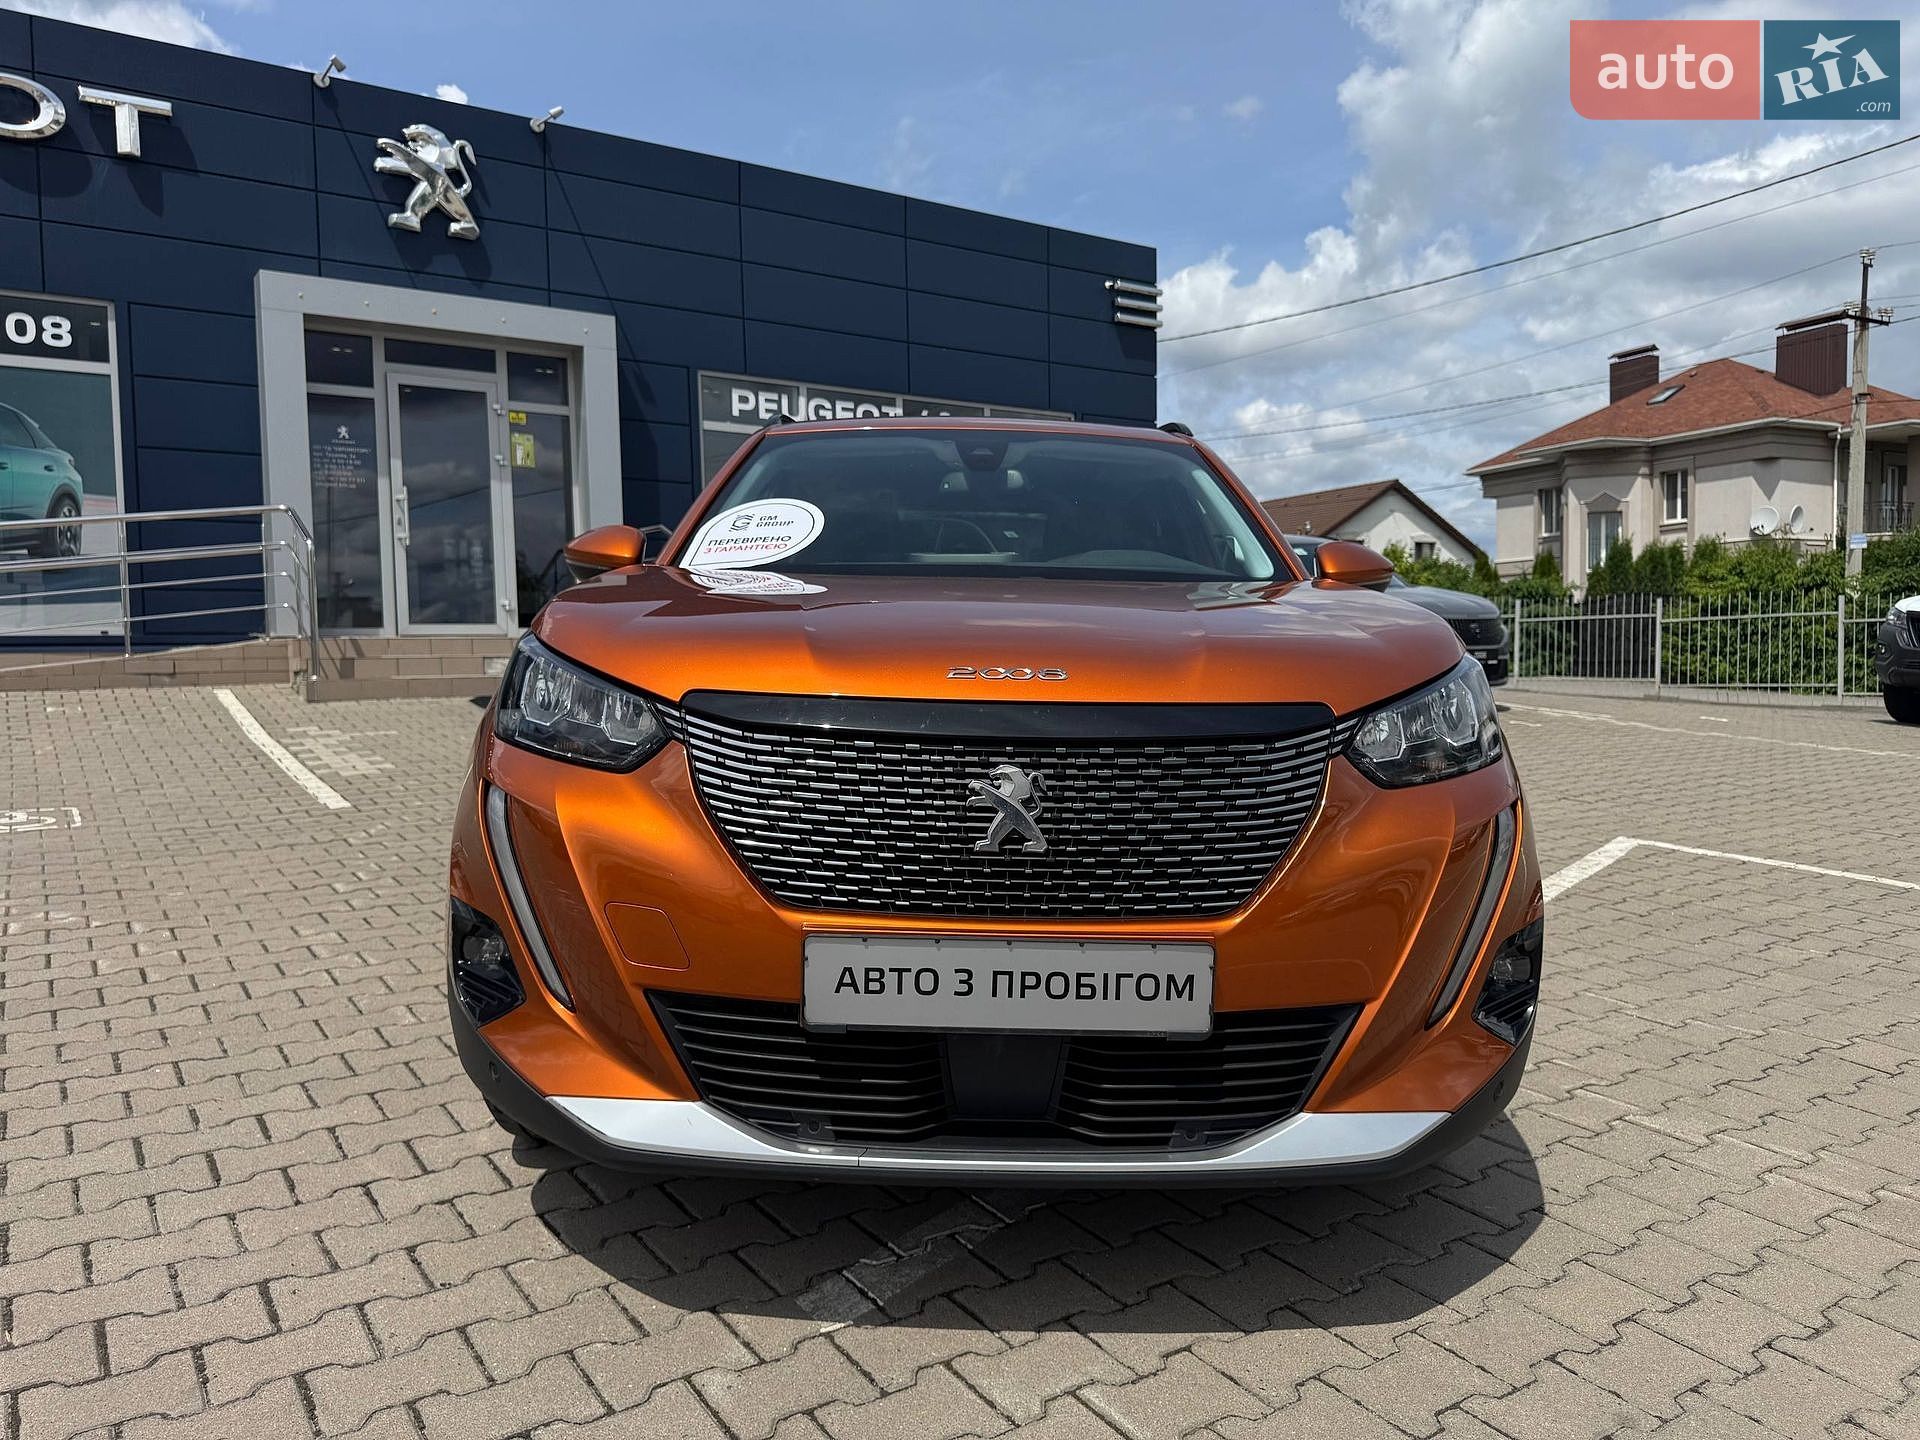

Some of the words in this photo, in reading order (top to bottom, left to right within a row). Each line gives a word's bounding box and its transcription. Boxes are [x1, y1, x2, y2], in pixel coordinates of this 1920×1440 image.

[5, 312, 73, 348] 08
[756, 520, 795, 528] GROUP
[707, 535, 792, 547] ПЕРЕВІРЕНО
[714, 543, 788, 554] ГАРАНТІЄЮ
[945, 666, 1069, 681] 2008
[833, 966, 940, 997] АВТО
[952, 968, 974, 997] З
[990, 969, 1196, 1002] ПРОБІГОМ
